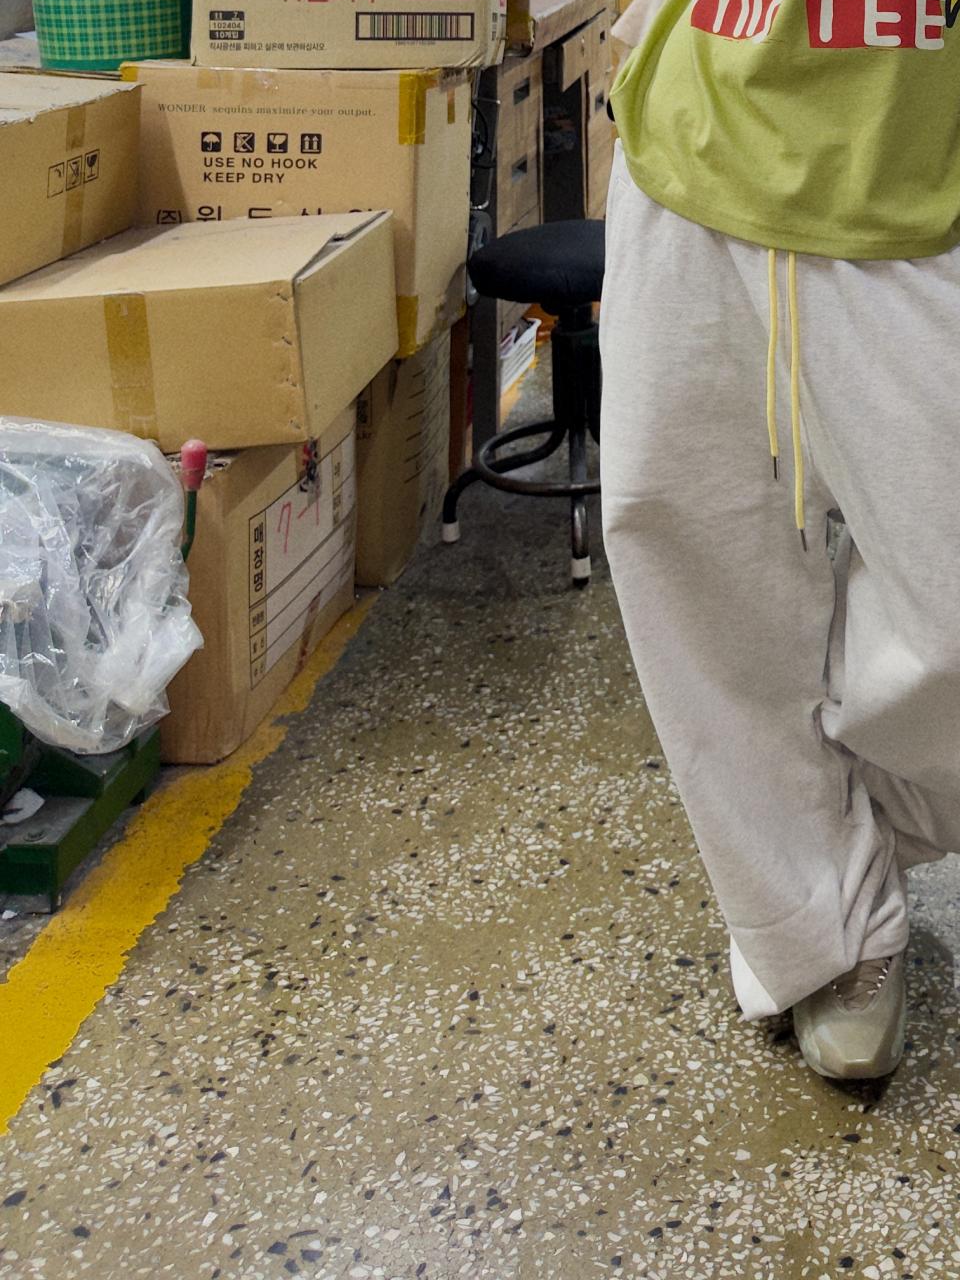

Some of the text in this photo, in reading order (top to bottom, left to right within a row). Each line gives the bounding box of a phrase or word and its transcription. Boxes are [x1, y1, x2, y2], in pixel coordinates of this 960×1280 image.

[157, 103, 207, 113] WONDER
[203, 157, 318, 170] USE NO HOOK
[203, 172, 286, 184] KEEP DRY
[253, 522, 264, 593] 매장명
